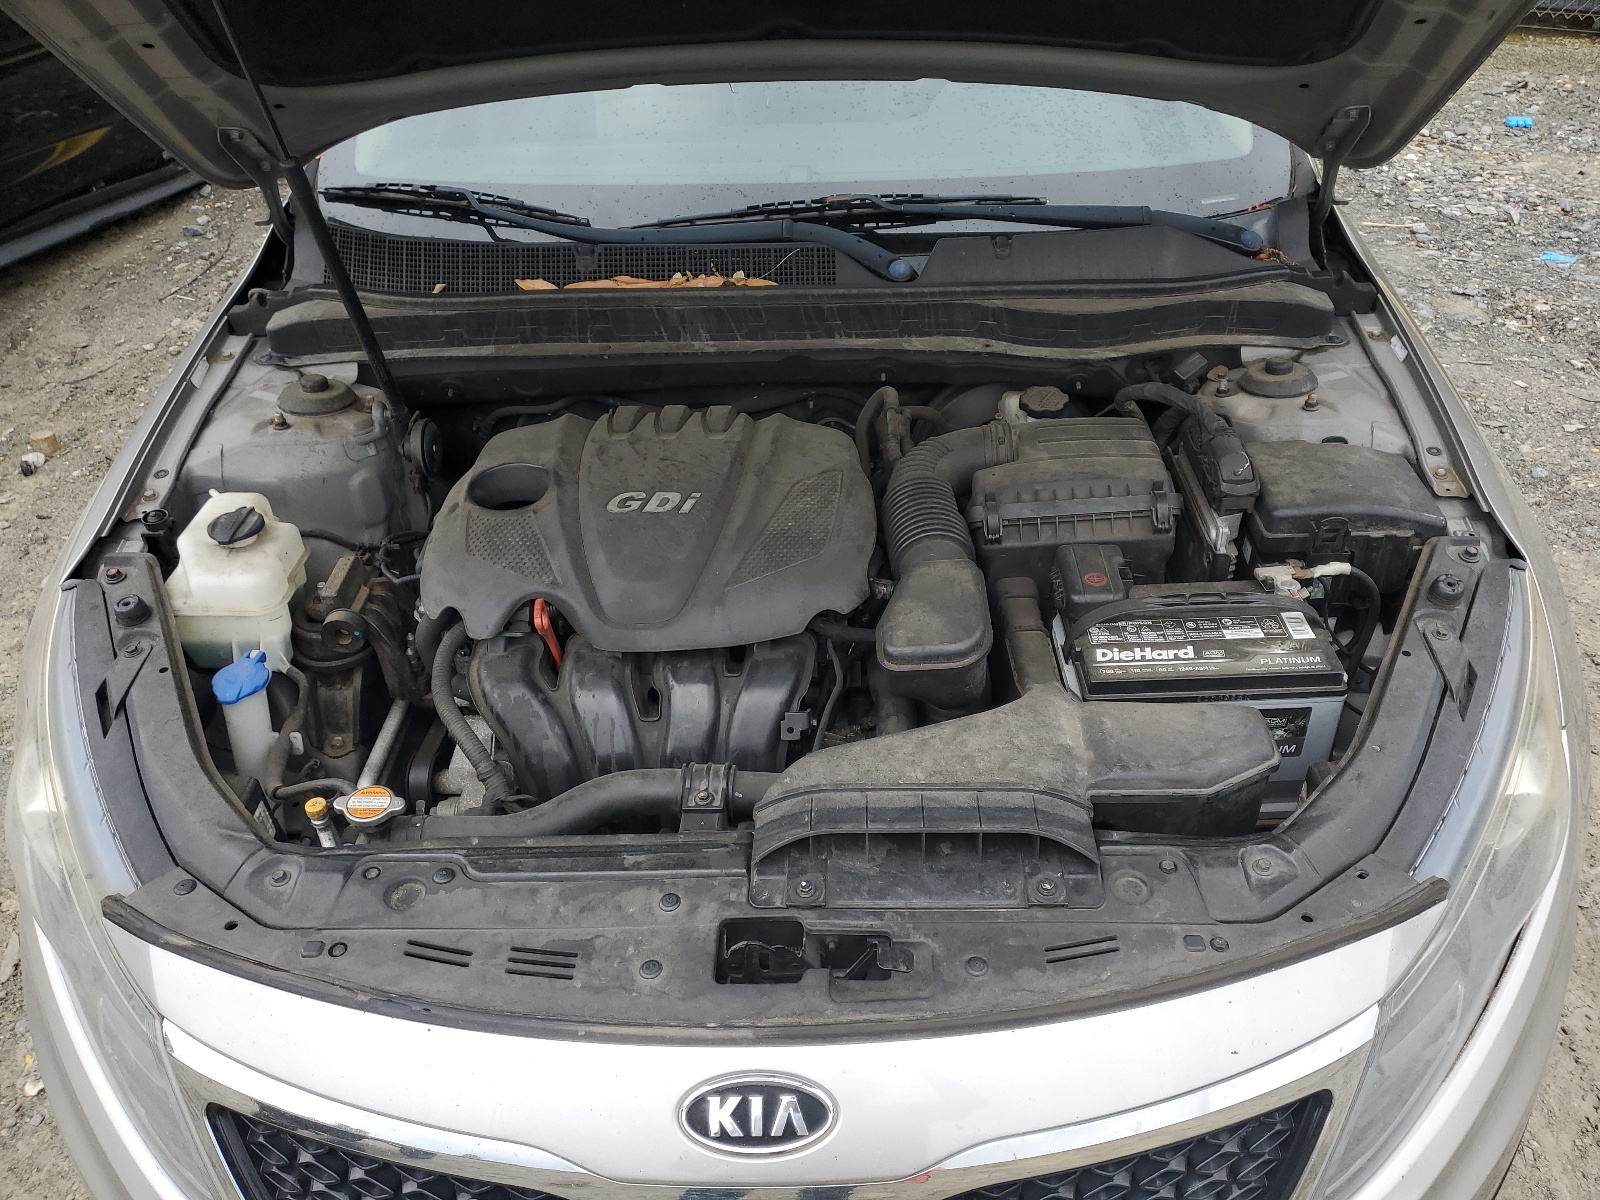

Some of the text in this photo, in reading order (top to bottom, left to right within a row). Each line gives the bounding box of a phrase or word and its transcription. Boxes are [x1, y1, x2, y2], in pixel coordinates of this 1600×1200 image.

[606, 491, 703, 514] GDi
[1096, 646, 1194, 662] DieHard
[1260, 656, 1321, 665] PLATINUM
[707, 1095, 809, 1138] KIA
